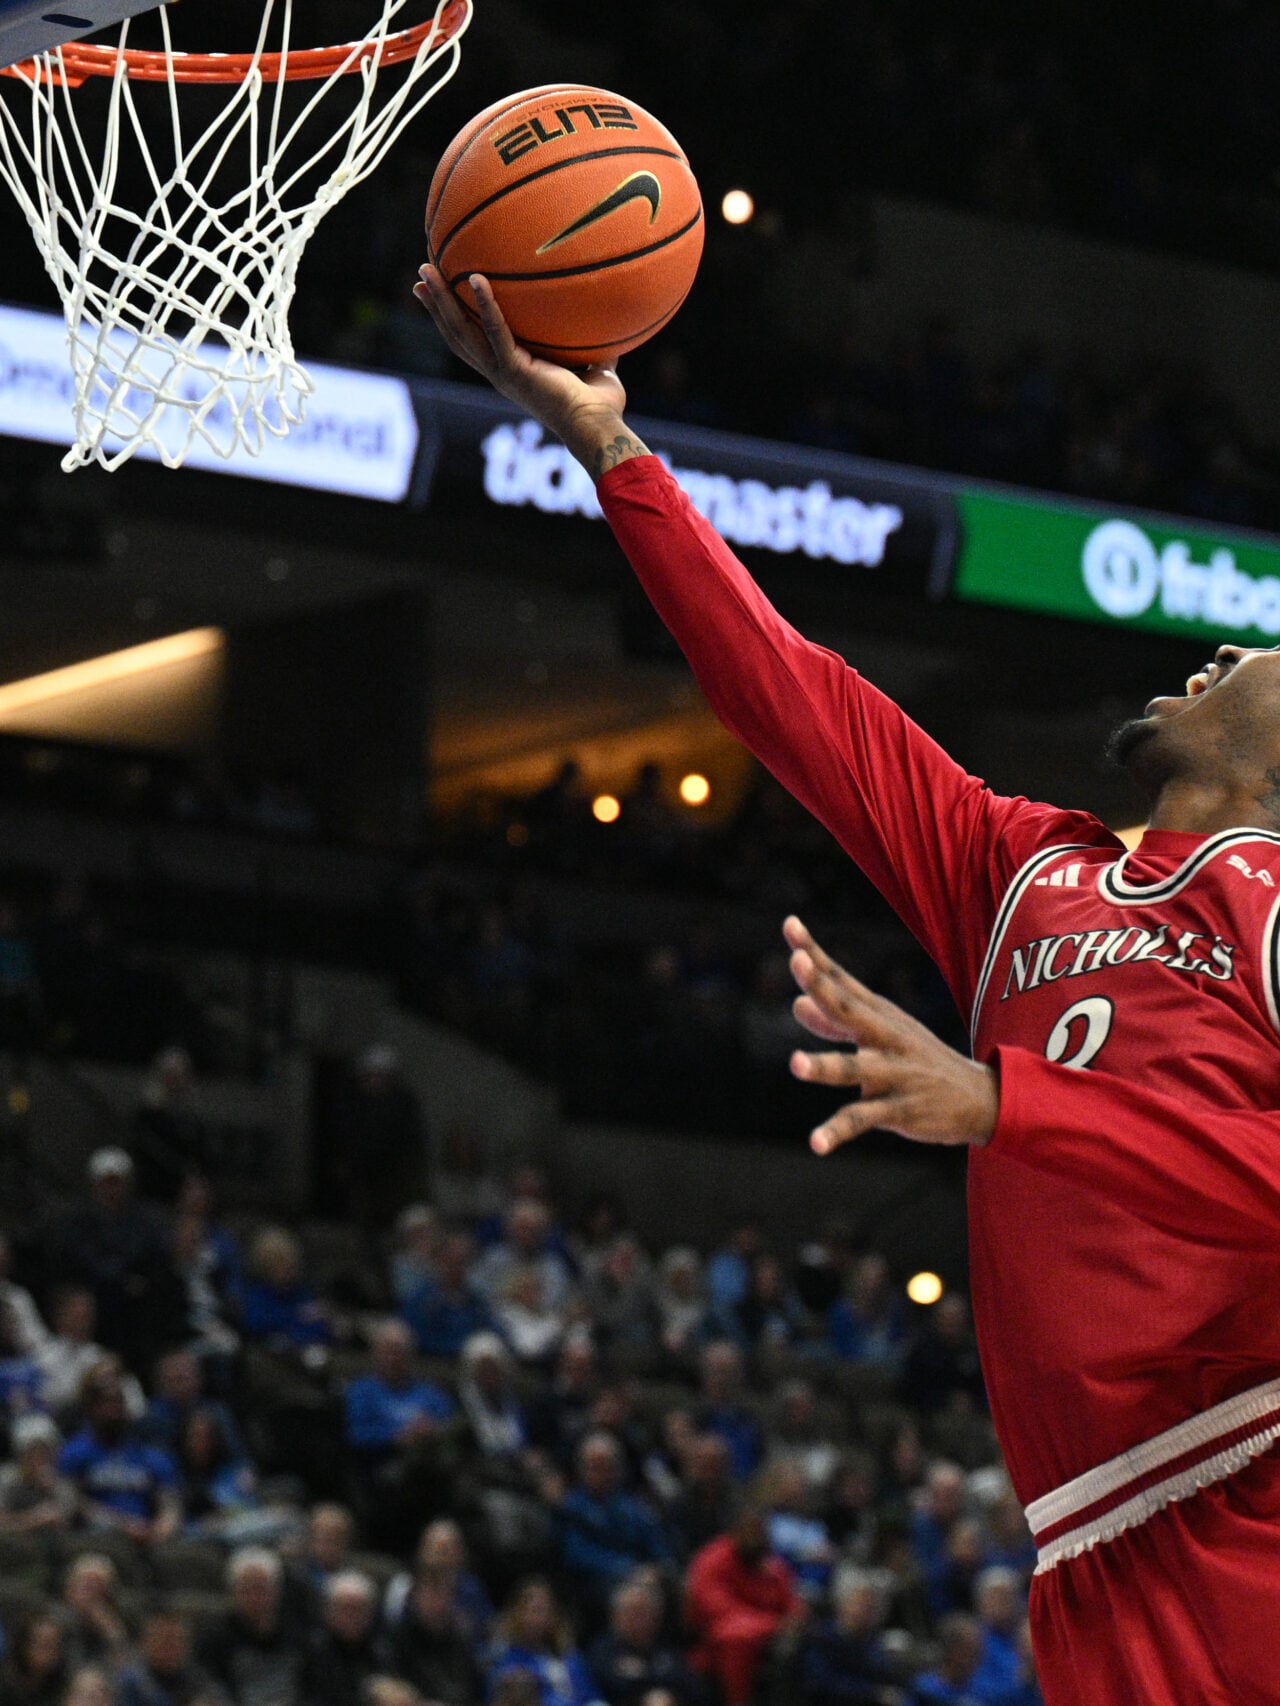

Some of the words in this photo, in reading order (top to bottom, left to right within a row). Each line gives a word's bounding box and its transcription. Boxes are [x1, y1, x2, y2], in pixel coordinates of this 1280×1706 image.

[494, 104, 638, 166] ELITE
[480, 421, 904, 568] ticmaster
[1000, 924, 1236, 1001] NICHOLLS
